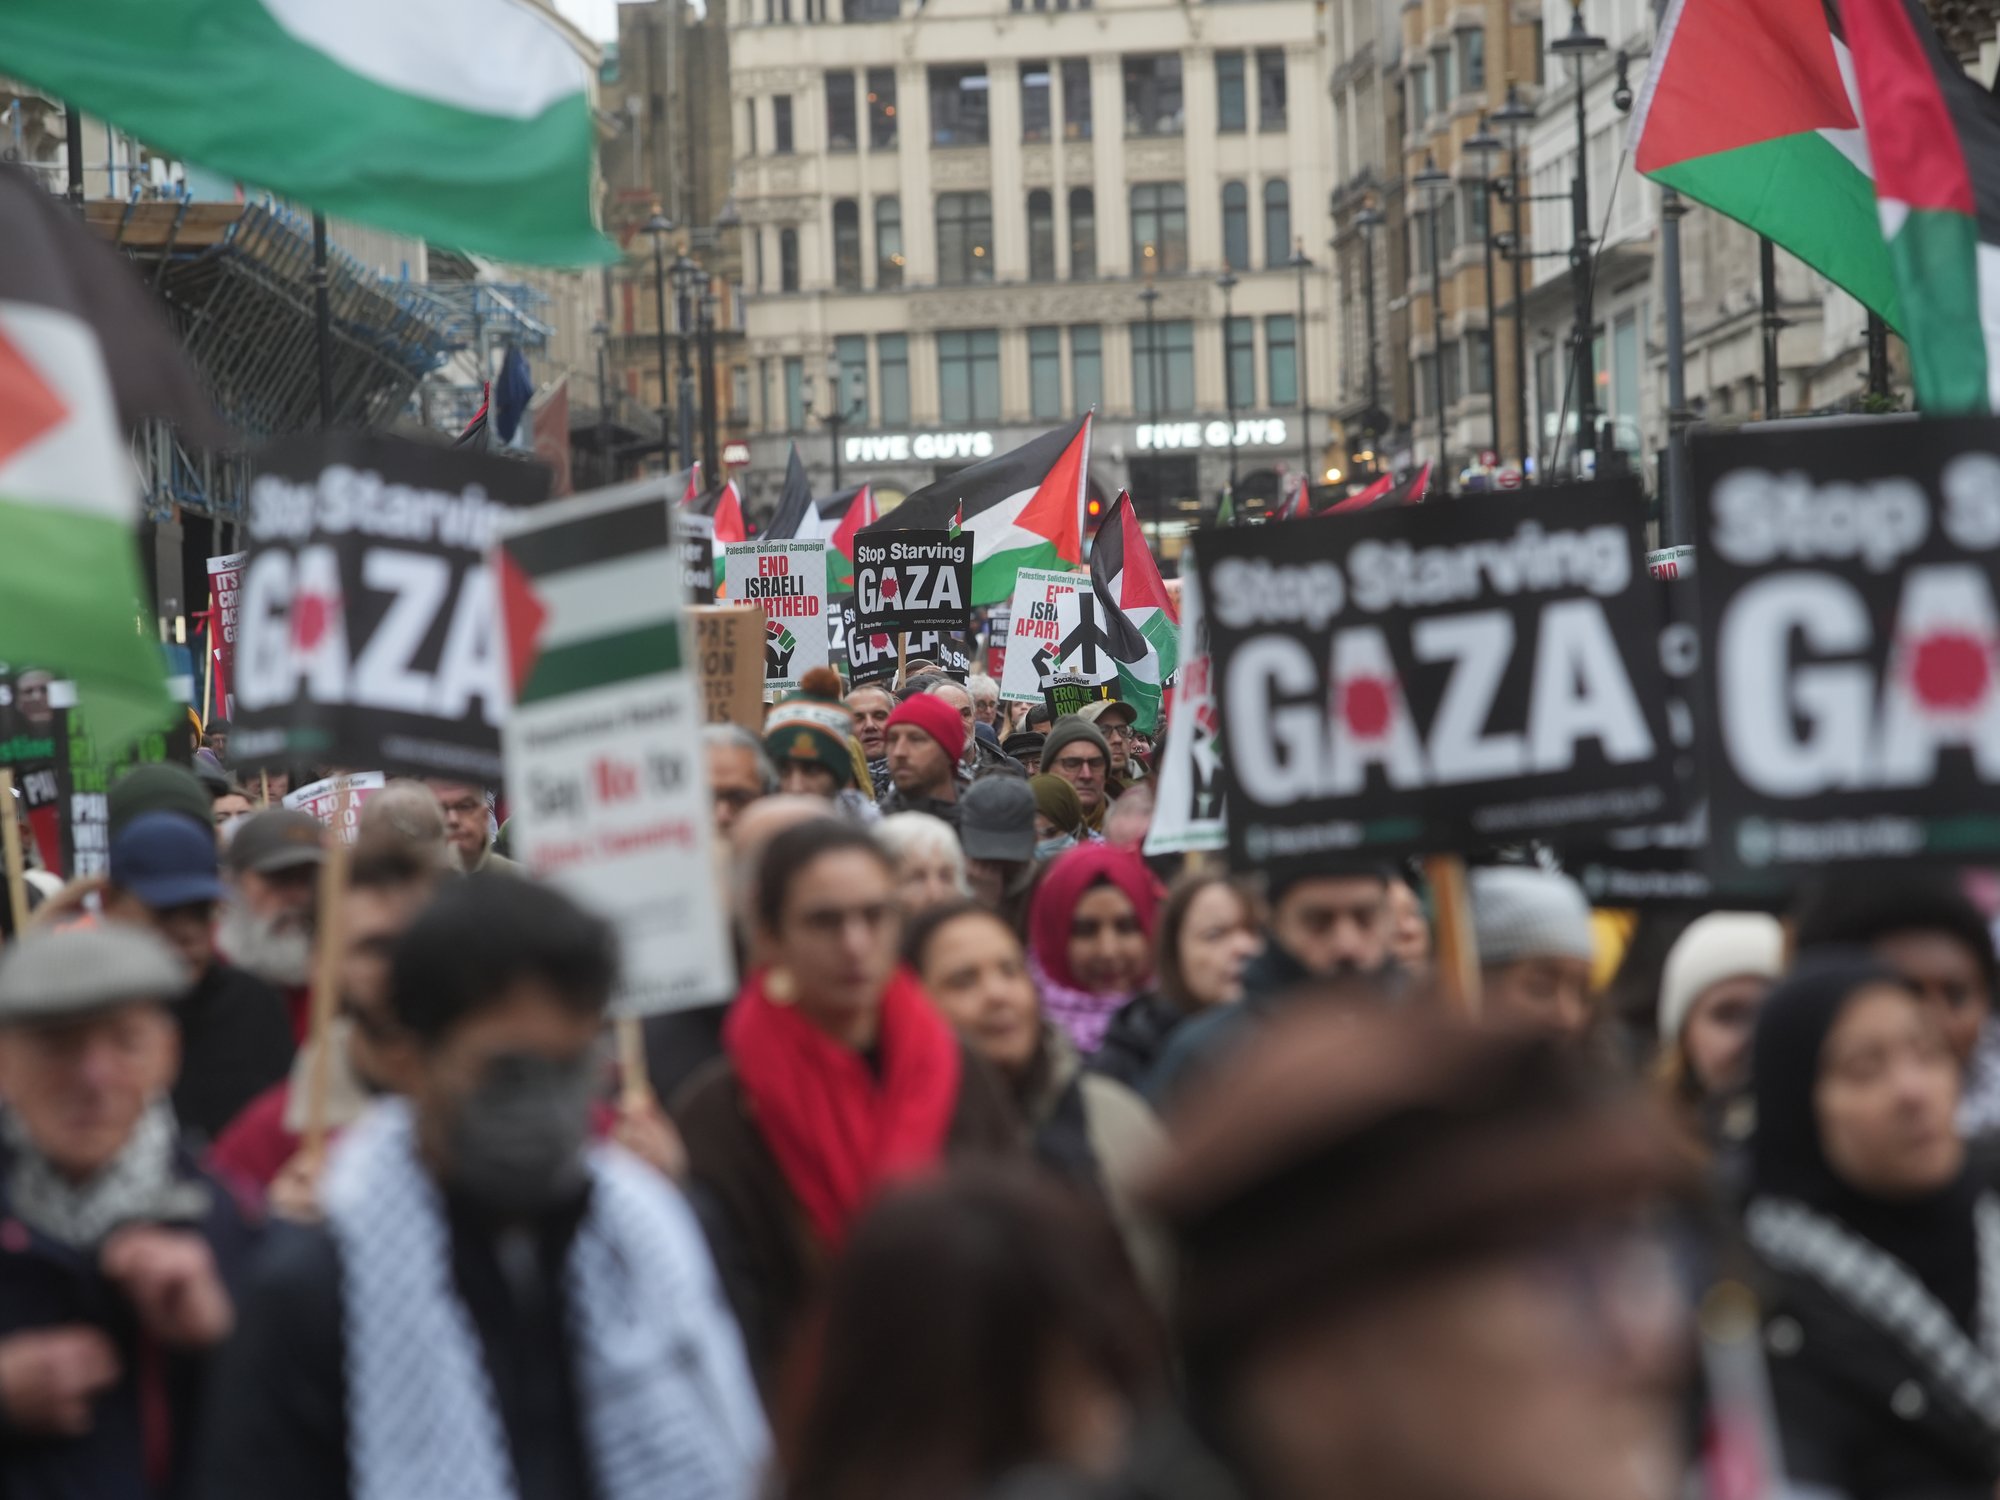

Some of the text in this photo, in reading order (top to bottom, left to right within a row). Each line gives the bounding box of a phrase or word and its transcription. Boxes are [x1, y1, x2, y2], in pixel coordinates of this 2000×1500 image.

[846, 431, 993, 462] FIVE GUYS
[1136, 422, 1201, 449] FIVE
[1710, 468, 1930, 571] Stop
[726, 542, 824, 555] Palestine Solidarity Campaign
[858, 542, 965, 564] Stop Starving
[759, 556, 788, 577] END
[1018, 571, 1045, 581] Palestine
[1047, 574, 1075, 585] Solidarity
[1211, 521, 1631, 630] Stop Starving
[745, 575, 803, 598] ISRAELI
[859, 565, 962, 614] GAZA
[237, 546, 510, 727] GAZA
[1226, 599, 1654, 805] GAZA
